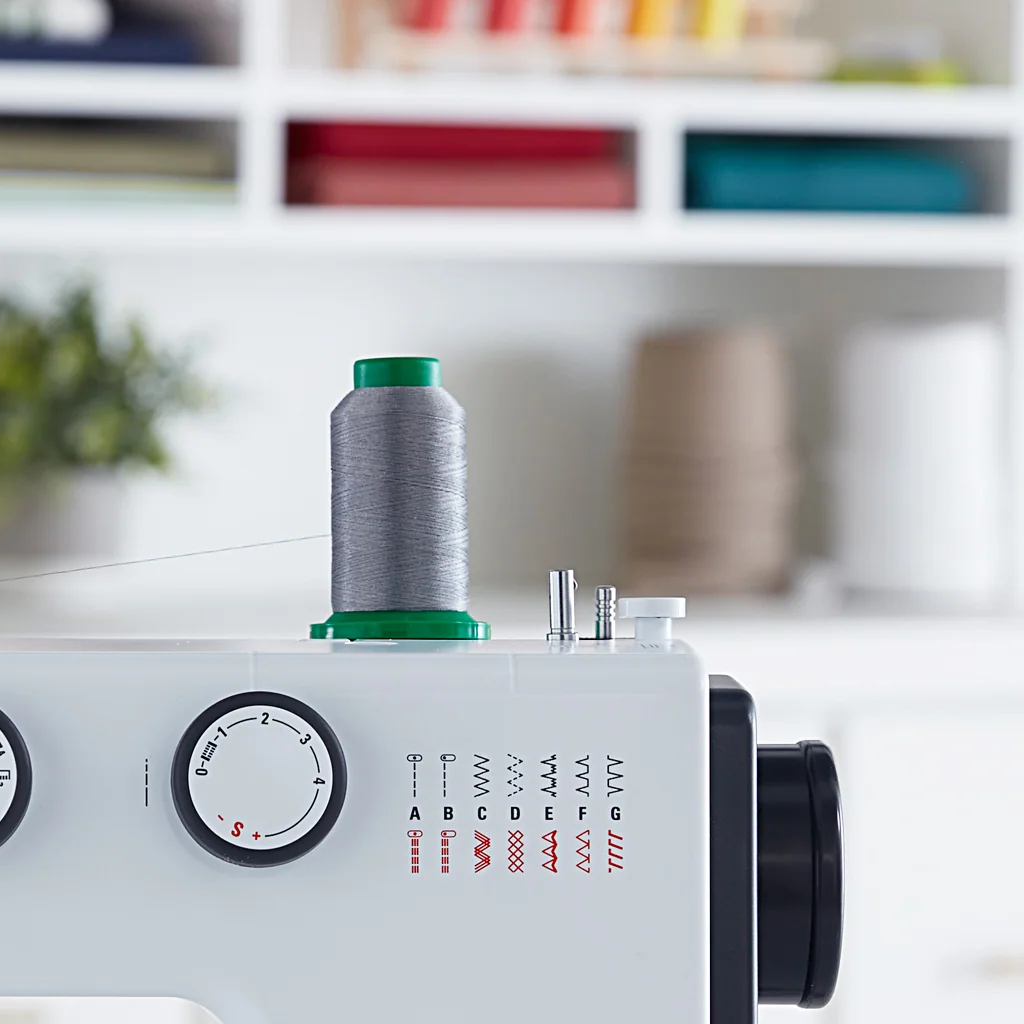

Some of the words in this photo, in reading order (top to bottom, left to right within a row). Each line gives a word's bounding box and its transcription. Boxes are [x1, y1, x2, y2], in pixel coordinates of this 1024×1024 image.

[261, 712, 270, 725] 2
[217, 726, 228, 738] 1
[299, 733, 312, 745] 3
[313, 777, 326, 785] 4
[409, 806, 421, 821] A
[443, 806, 454, 821] B
[477, 806, 487, 821] C
[510, 806, 521, 821] D
[545, 806, 554, 821] E
[579, 806, 587, 821] F
[610, 806, 621, 821] G
[231, 821, 244, 837] S
